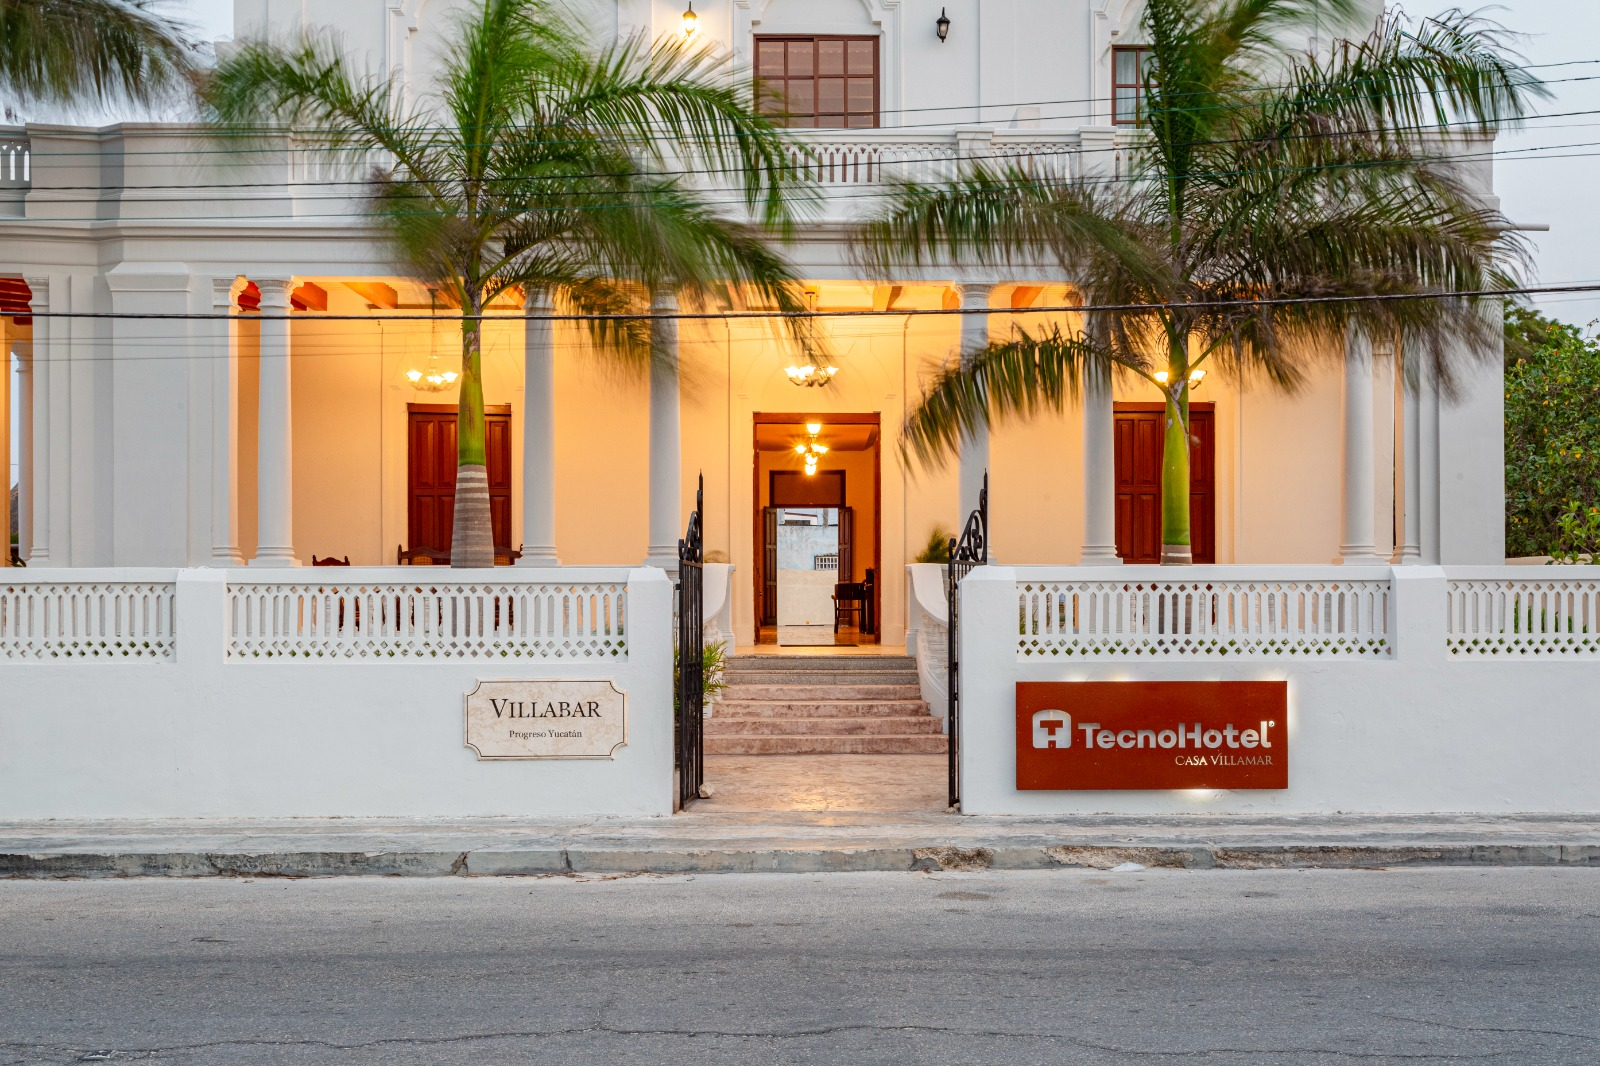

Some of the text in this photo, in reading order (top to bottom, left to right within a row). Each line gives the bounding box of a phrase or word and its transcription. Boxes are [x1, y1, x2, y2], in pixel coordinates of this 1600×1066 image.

[489, 698, 602, 718] VILLABAR
[509, 729, 582, 740] Progreso Yucatán
[1078, 720, 1274, 749] TecnoHotel
[1175, 753, 1273, 766] CASA VILLAMAR
